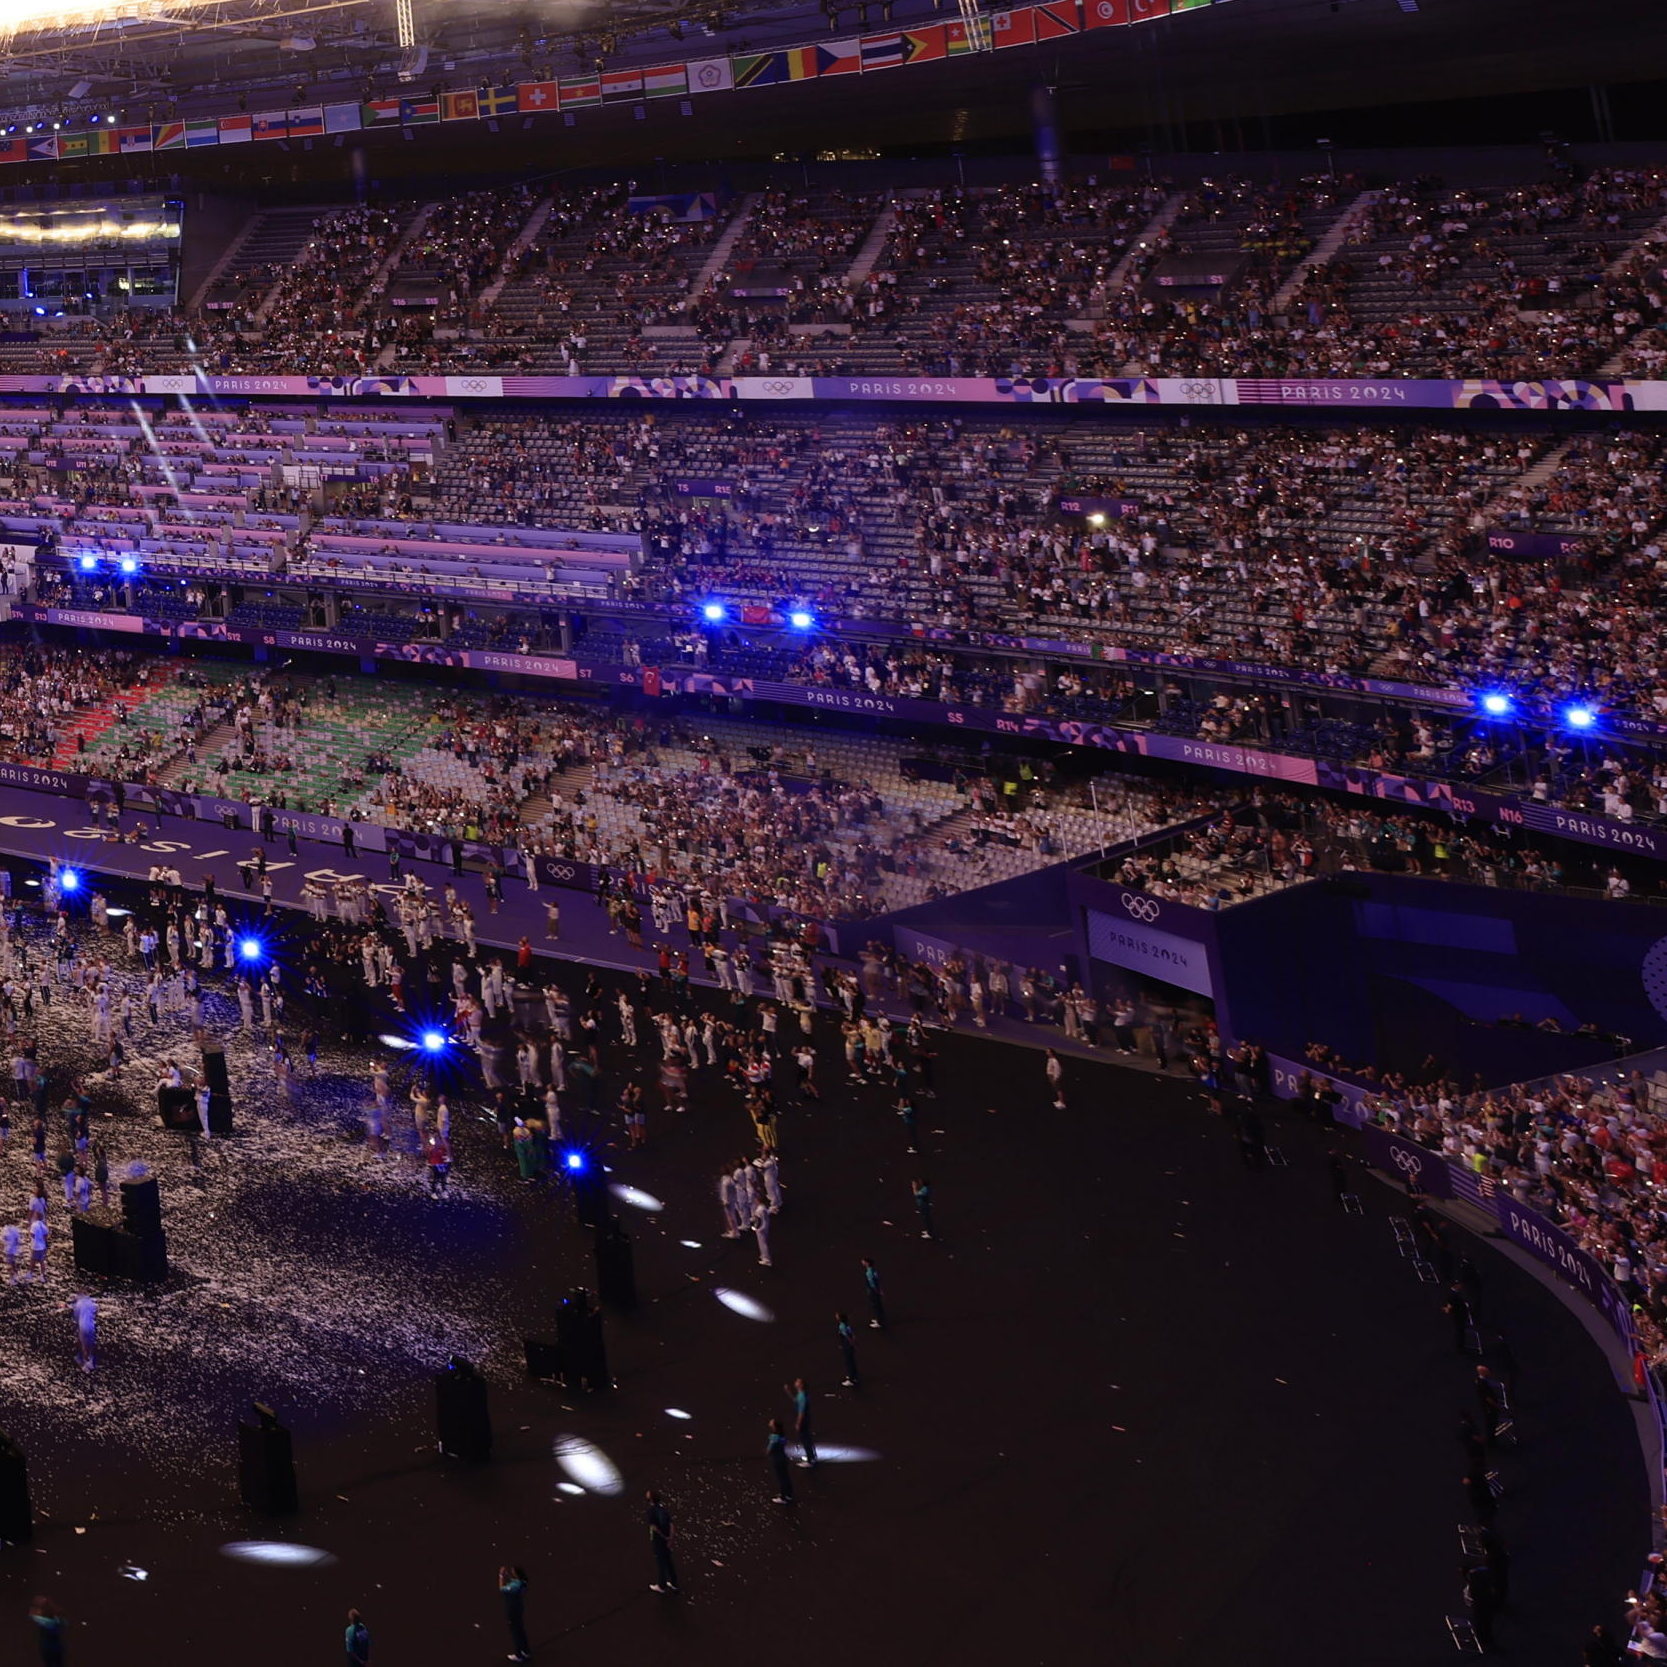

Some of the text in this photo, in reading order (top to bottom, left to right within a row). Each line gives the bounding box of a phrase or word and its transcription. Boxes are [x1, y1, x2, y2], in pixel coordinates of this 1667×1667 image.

[215, 380, 288, 390] PARIS 2024
[850, 383, 956, 396] PARIS 2024
[1282, 386, 1405, 400] PARIS 2024
[1060, 501, 1081, 512] R12
[1488, 538, 1515, 550] R10
[58, 613, 114, 626] PARIS 2024
[291, 636, 356, 652] PARIS 2024
[484, 656, 559, 672] PARIS 2024
[579, 668, 592, 678] S7
[620, 673, 634, 683] S6
[807, 691, 894, 712] PARIS 2024
[947, 712, 964, 724] S5
[996, 719, 1019, 732] R14
[1184, 744, 1276, 771] PARIS 2024
[33, 773, 68, 789] 2024
[1453, 798, 1476, 813] R13
[1499, 808, 1524, 824] N16
[1556, 816, 1655, 851] PARIS 2024
[1110, 932, 1189, 968] PARIS 2024
[1509, 1212, 1592, 1291] PARIS 2024
